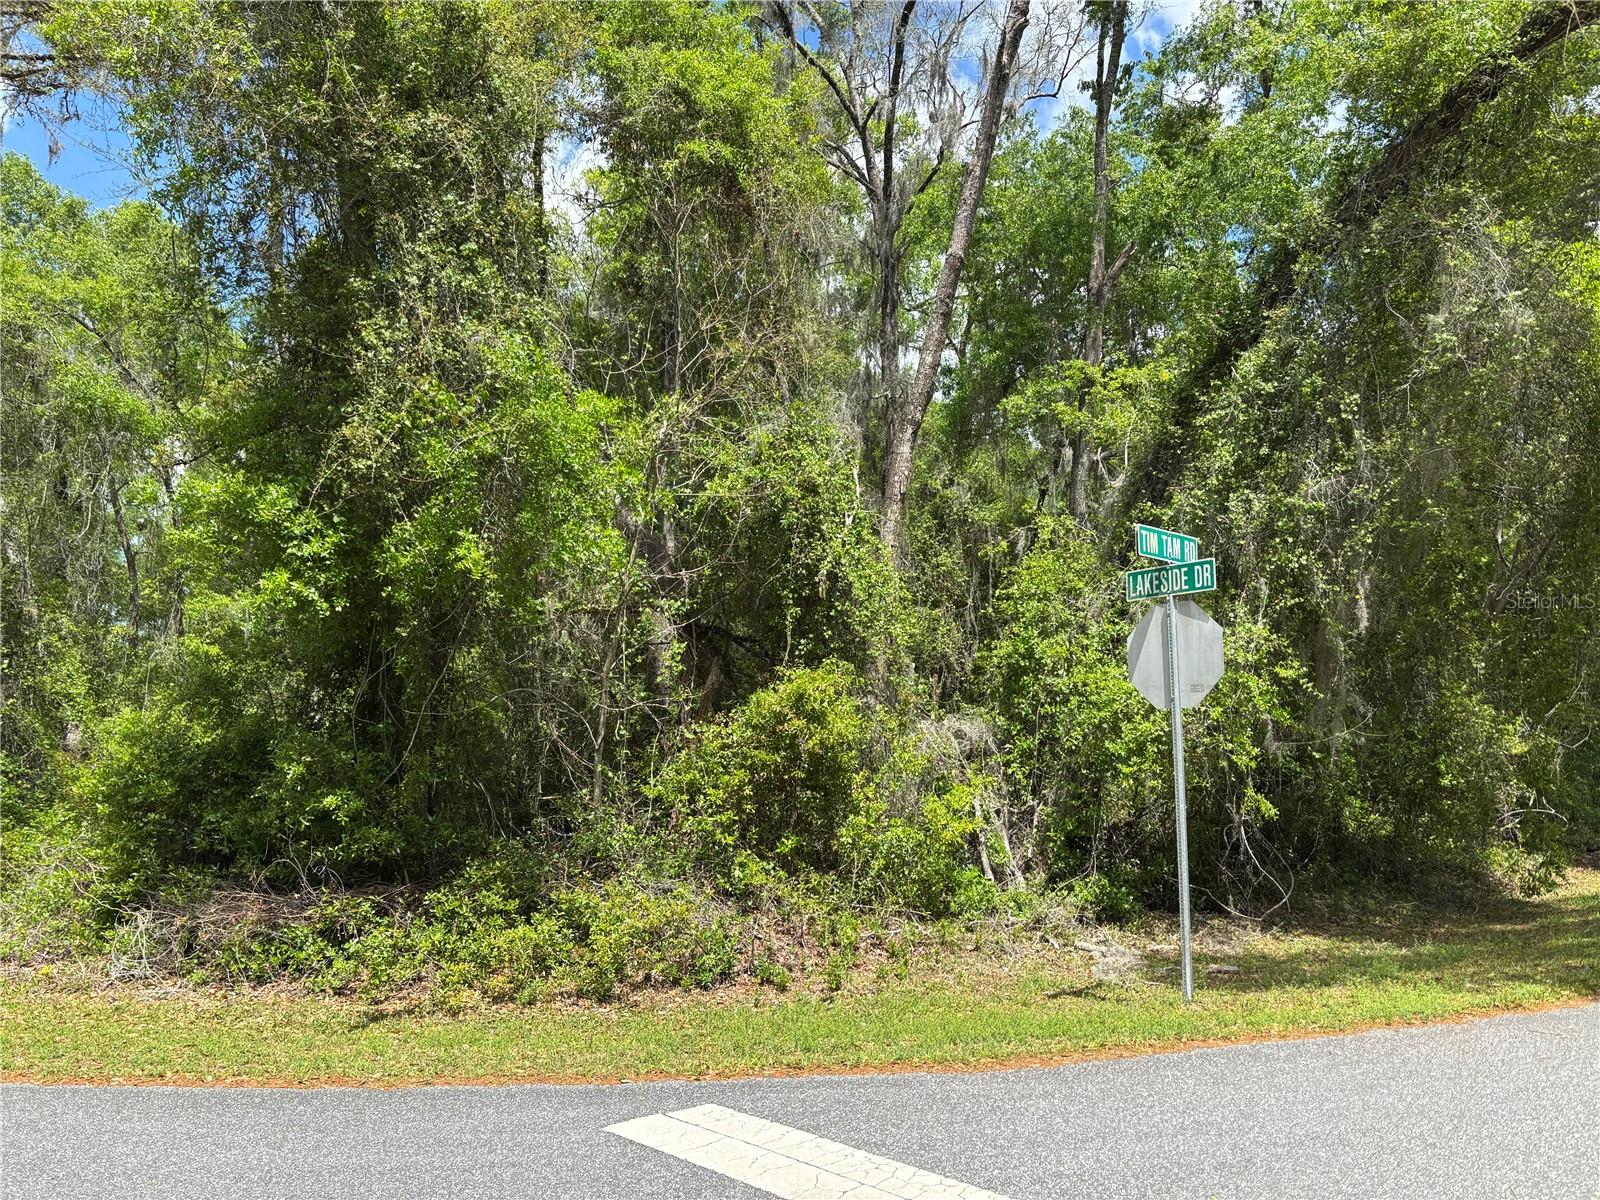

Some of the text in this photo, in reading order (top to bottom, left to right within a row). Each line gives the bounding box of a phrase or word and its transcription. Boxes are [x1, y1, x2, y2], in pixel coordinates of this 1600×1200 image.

[1141, 529, 1196, 562] TIM TAM RD
[1130, 564, 1212, 597] LAKESIDE DR
